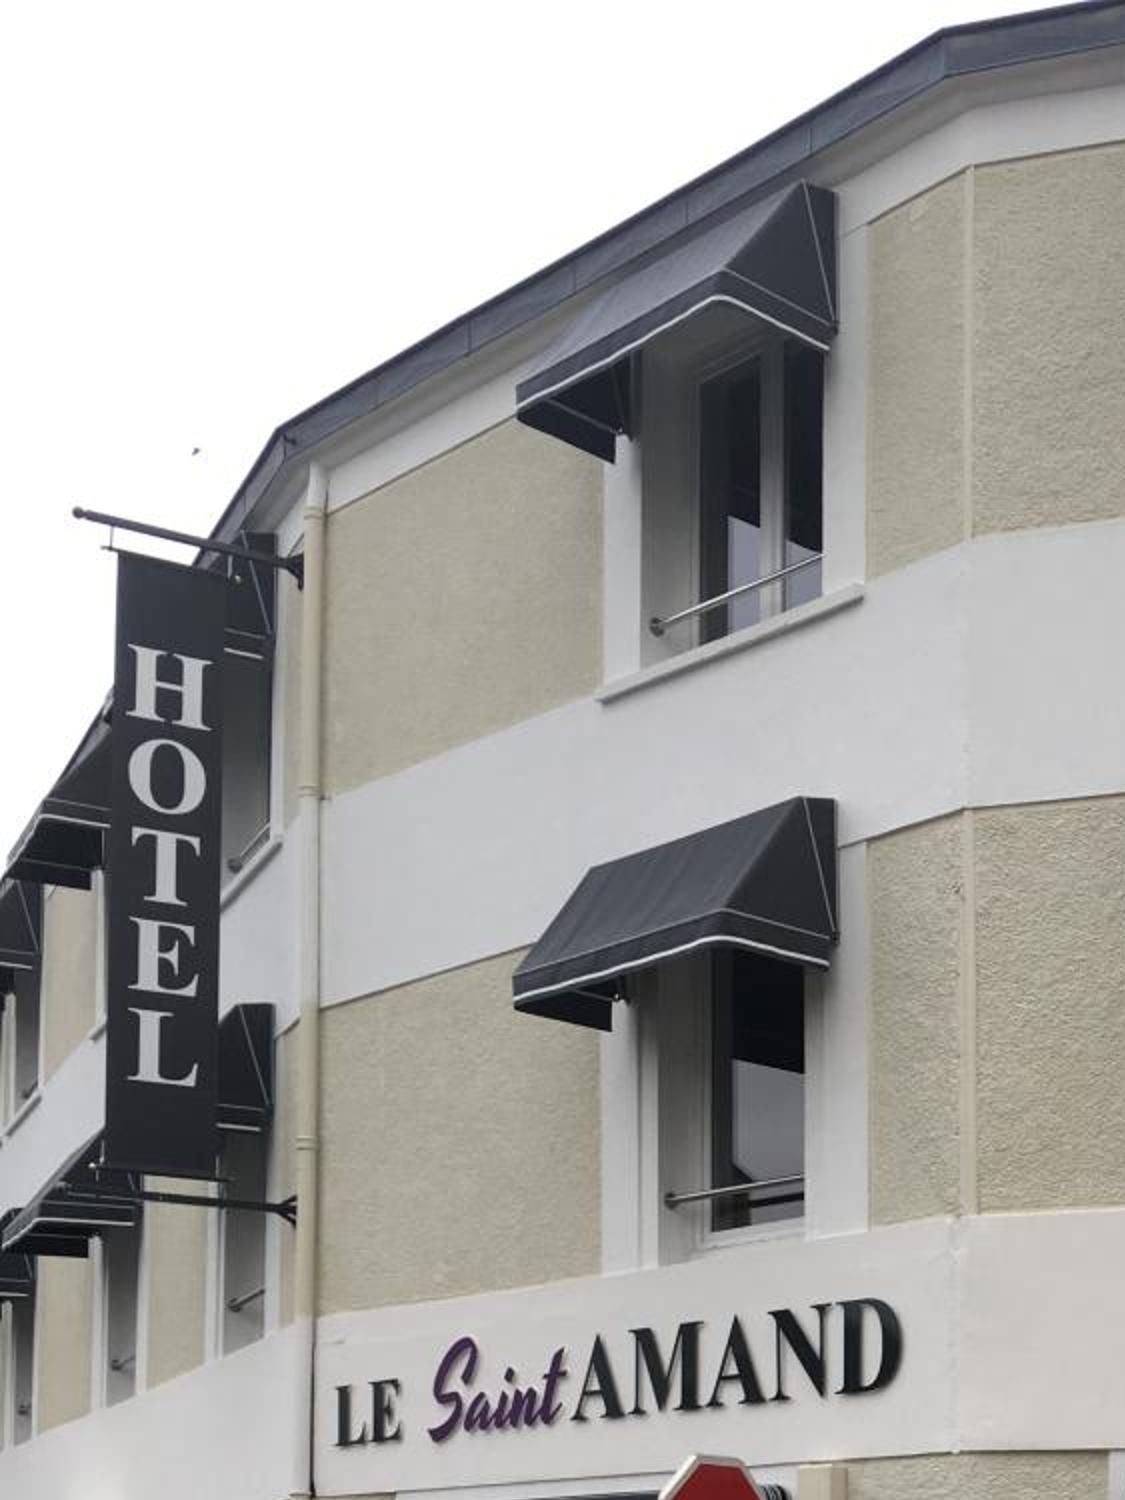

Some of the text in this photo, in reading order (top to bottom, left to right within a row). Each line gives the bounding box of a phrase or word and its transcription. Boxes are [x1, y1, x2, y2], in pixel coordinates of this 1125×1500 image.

[125, 643, 213, 1088] HOTEL
[335, 1297, 905, 1448] LE Saint AMAND
